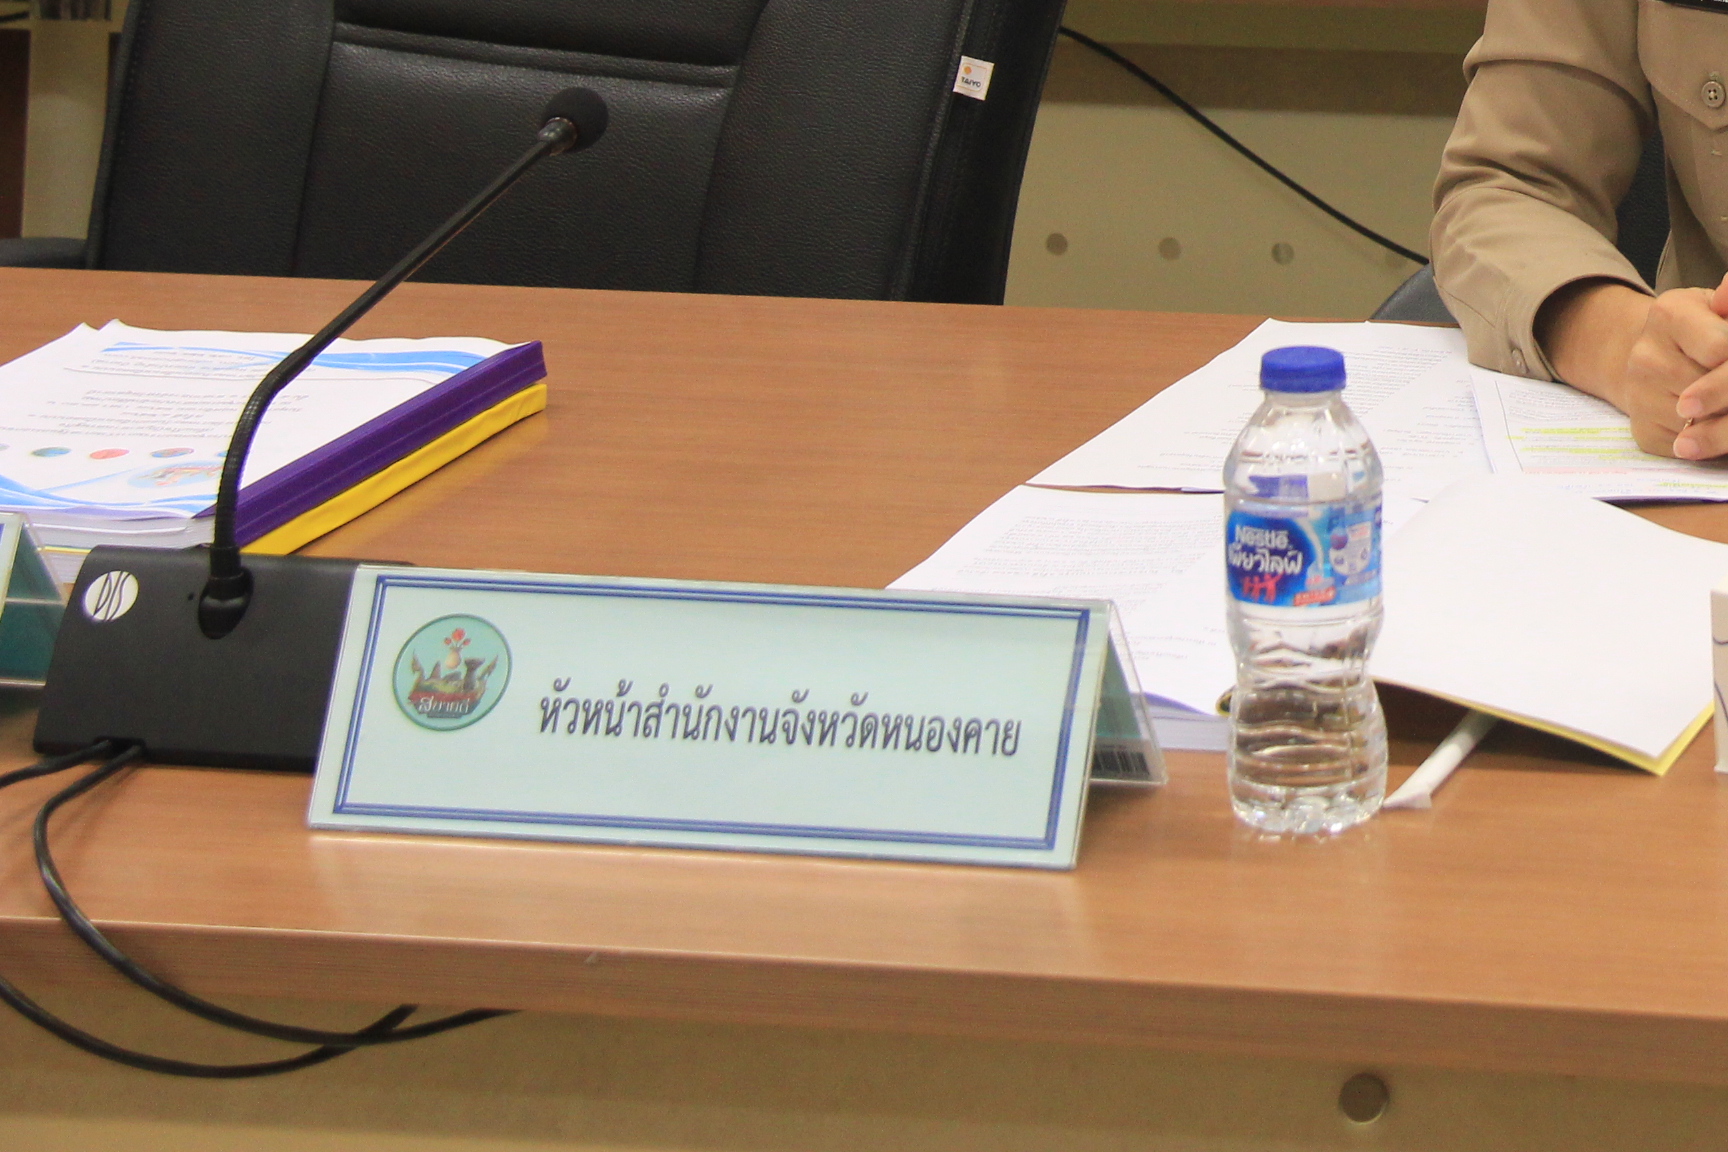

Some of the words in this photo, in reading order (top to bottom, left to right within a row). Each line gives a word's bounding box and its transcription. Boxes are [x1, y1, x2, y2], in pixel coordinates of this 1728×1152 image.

[1235, 524, 1290, 550] Nestlé
[539, 676, 1021, 759] หัวหน้าสำนักงานจังหวัดหนองคาย
